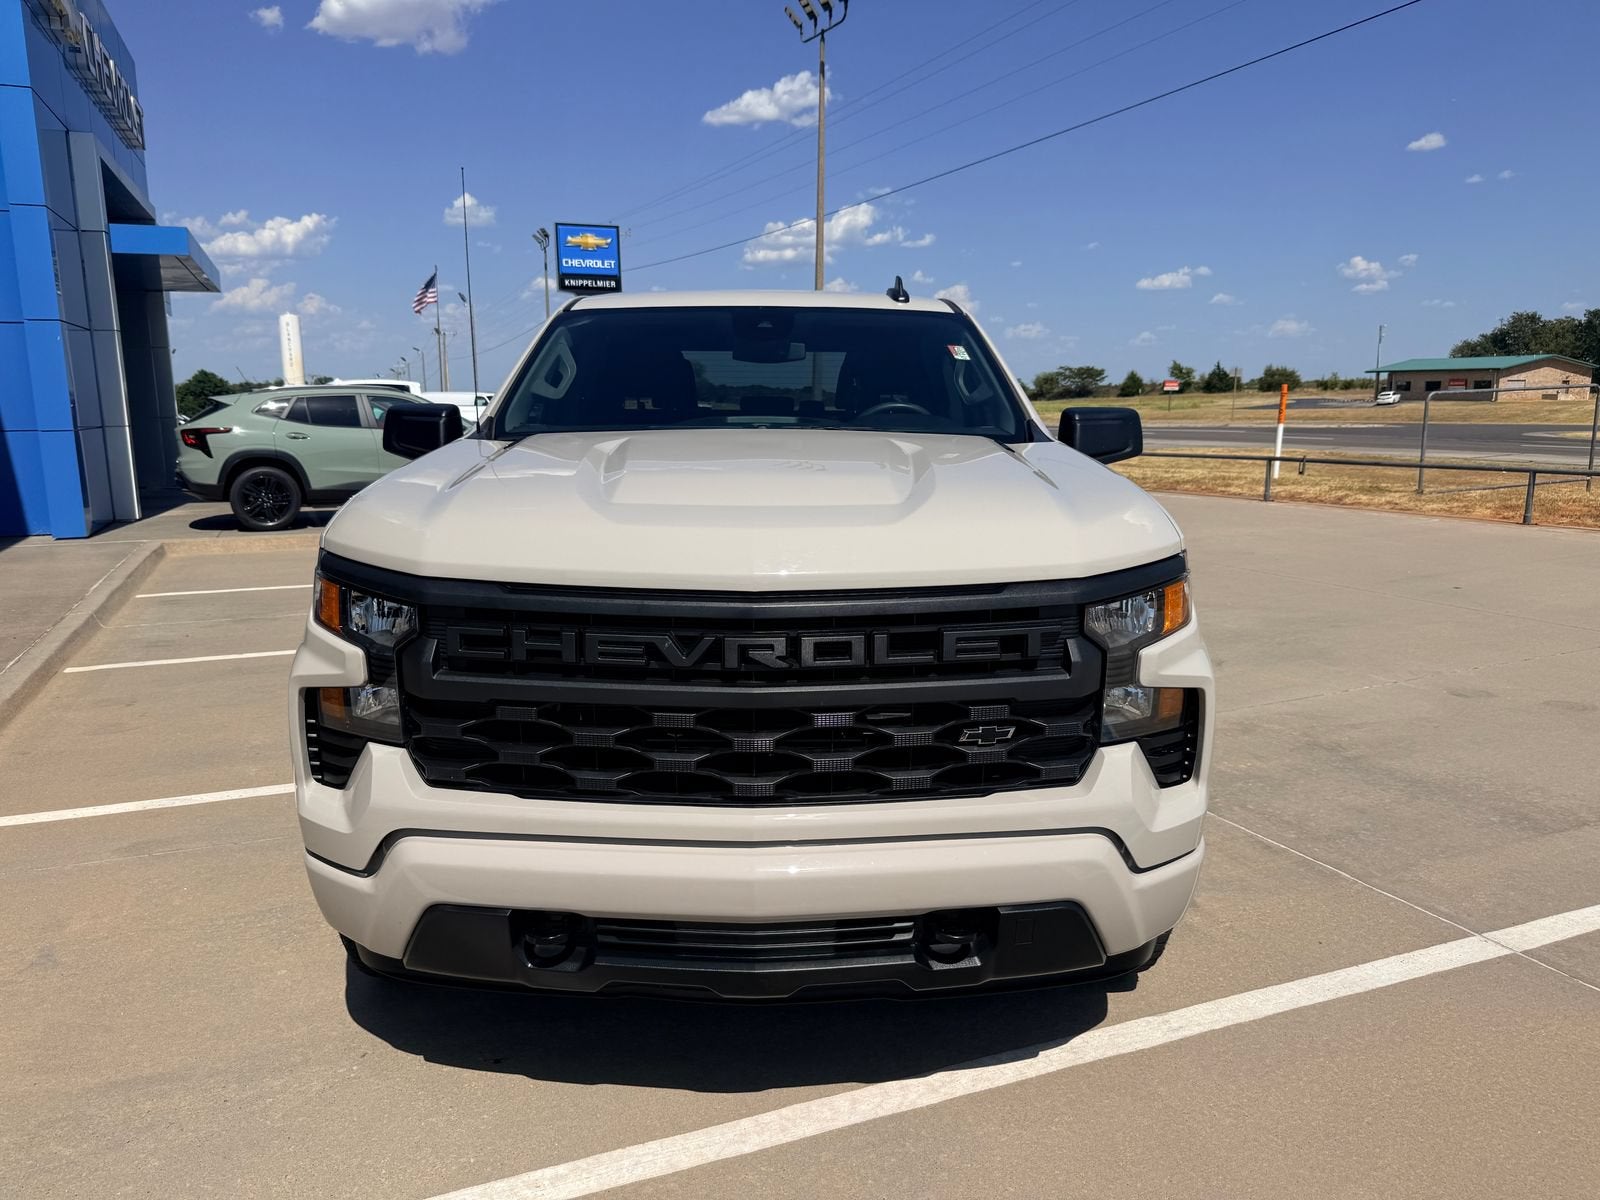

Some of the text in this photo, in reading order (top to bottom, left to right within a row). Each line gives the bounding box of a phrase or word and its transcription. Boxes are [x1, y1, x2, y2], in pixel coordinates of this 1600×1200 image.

[562, 258, 616, 269] CHEVROLET
[564, 279, 616, 288] KNIPPELMIER
[447, 625, 1062, 669] CHEVROLET
